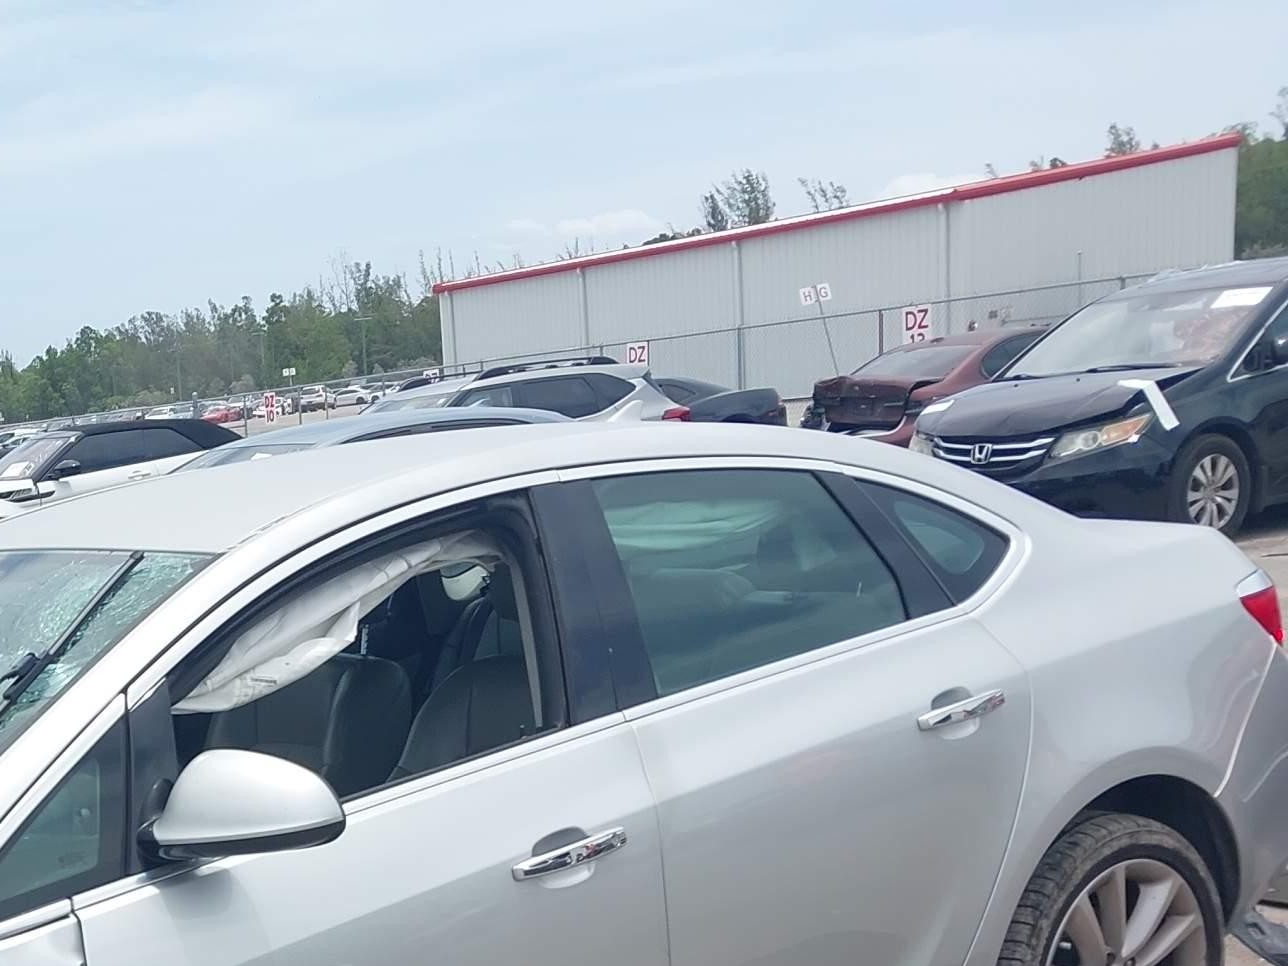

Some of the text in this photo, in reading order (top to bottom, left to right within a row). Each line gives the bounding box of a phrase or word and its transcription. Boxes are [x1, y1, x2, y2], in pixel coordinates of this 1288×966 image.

[819, 287, 828, 298] G
[905, 308, 929, 331] DZ
[629, 346, 646, 363] DZ
[265, 395, 275, 408] DZ
[266, 410, 275, 423] 10
